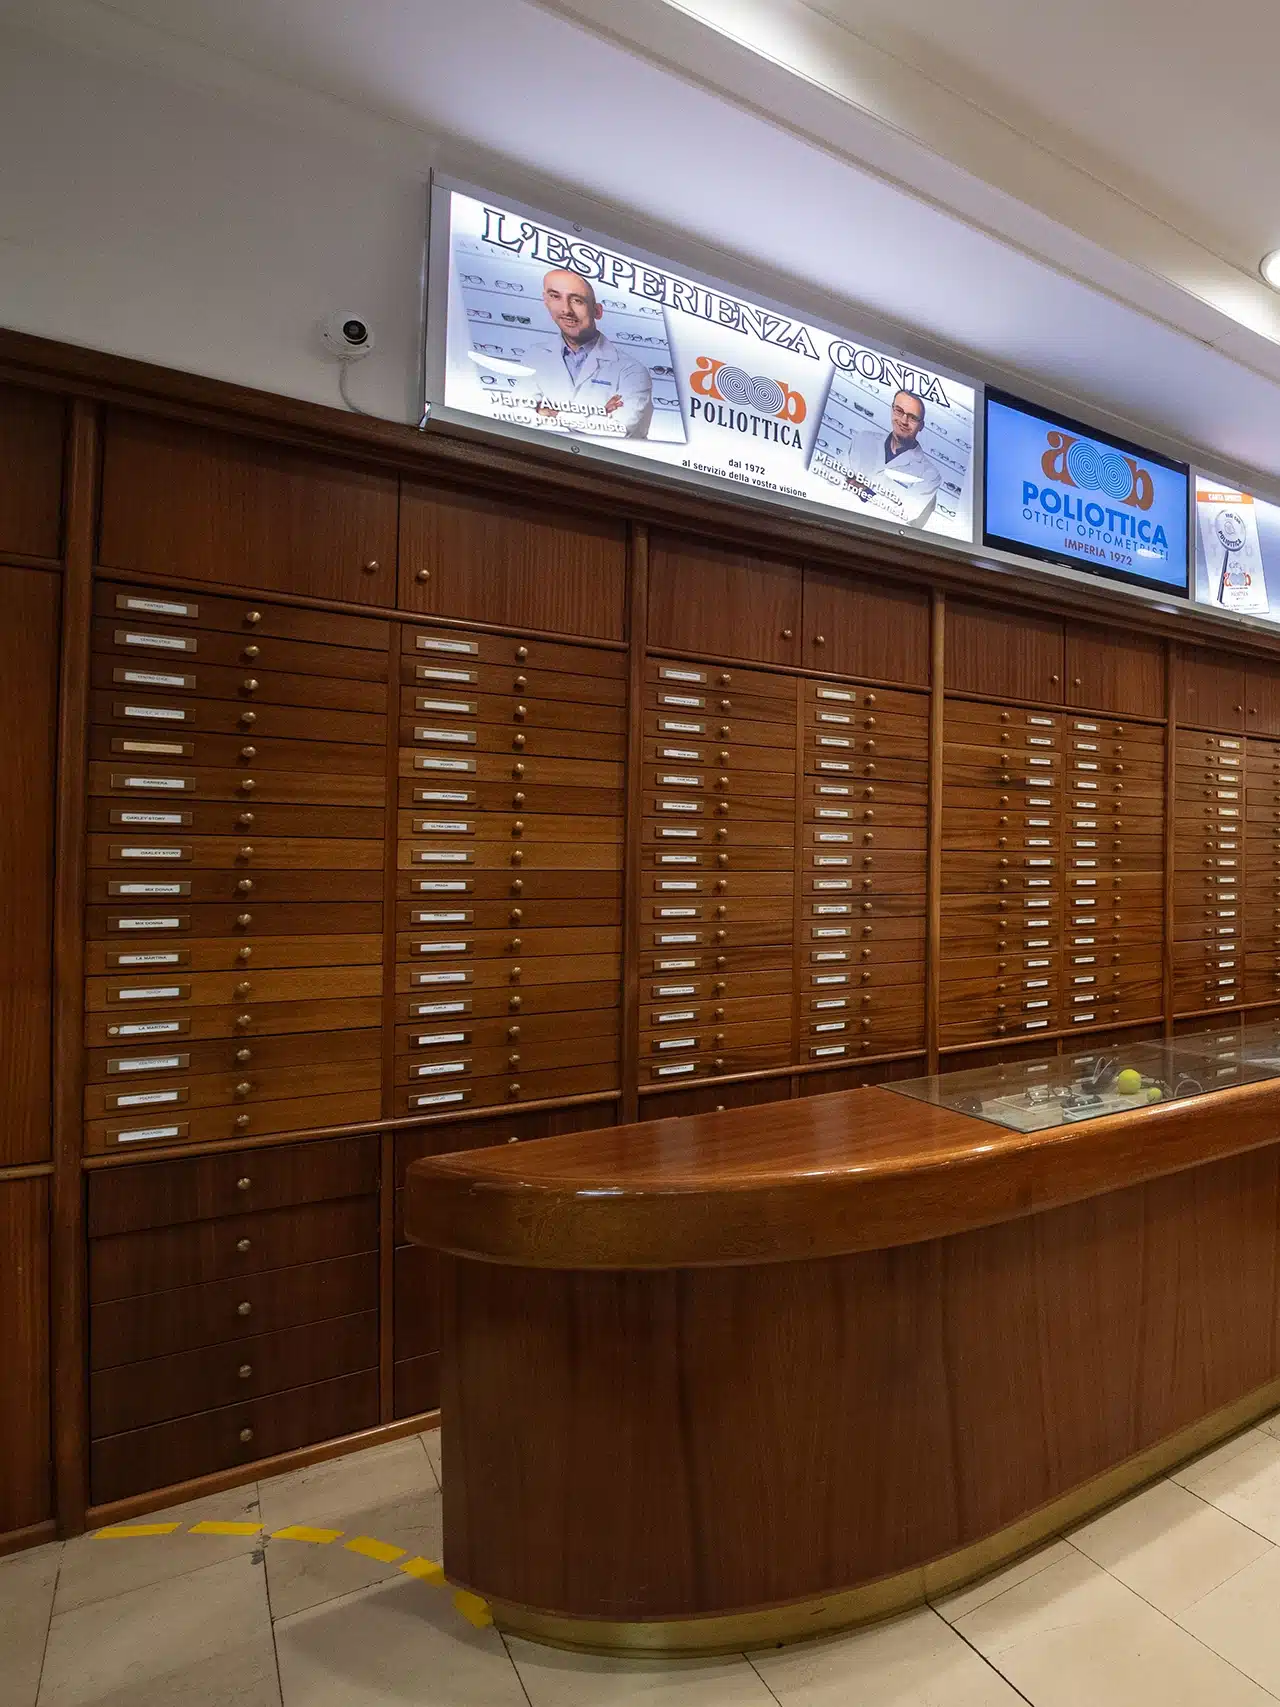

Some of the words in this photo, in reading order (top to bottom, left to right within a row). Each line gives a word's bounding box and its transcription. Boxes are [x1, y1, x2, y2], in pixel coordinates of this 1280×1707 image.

[482, 207, 819, 360] L'ESPERIENZA
[827, 340, 950, 408] CONTA
[490, 392, 537, 409] Marco
[539, 396, 612, 418] Audagna,
[536, 413, 627, 432] professionista
[690, 397, 803, 449] POLIOTTICA
[728, 459, 742, 468] dal
[745, 463, 766, 475] 1972
[815, 451, 855, 479] Matteo
[693, 463, 726, 477] servizio
[728, 471, 750, 483] della
[752, 478, 777, 490] vostra
[779, 485, 807, 498] visione
[1022, 480, 1169, 548] POLIOTTICA
[1022, 508, 1074, 532] OTTICI
[1064, 538, 1107, 559] IMPERIA
[1110, 547, 1133, 566] 1972
